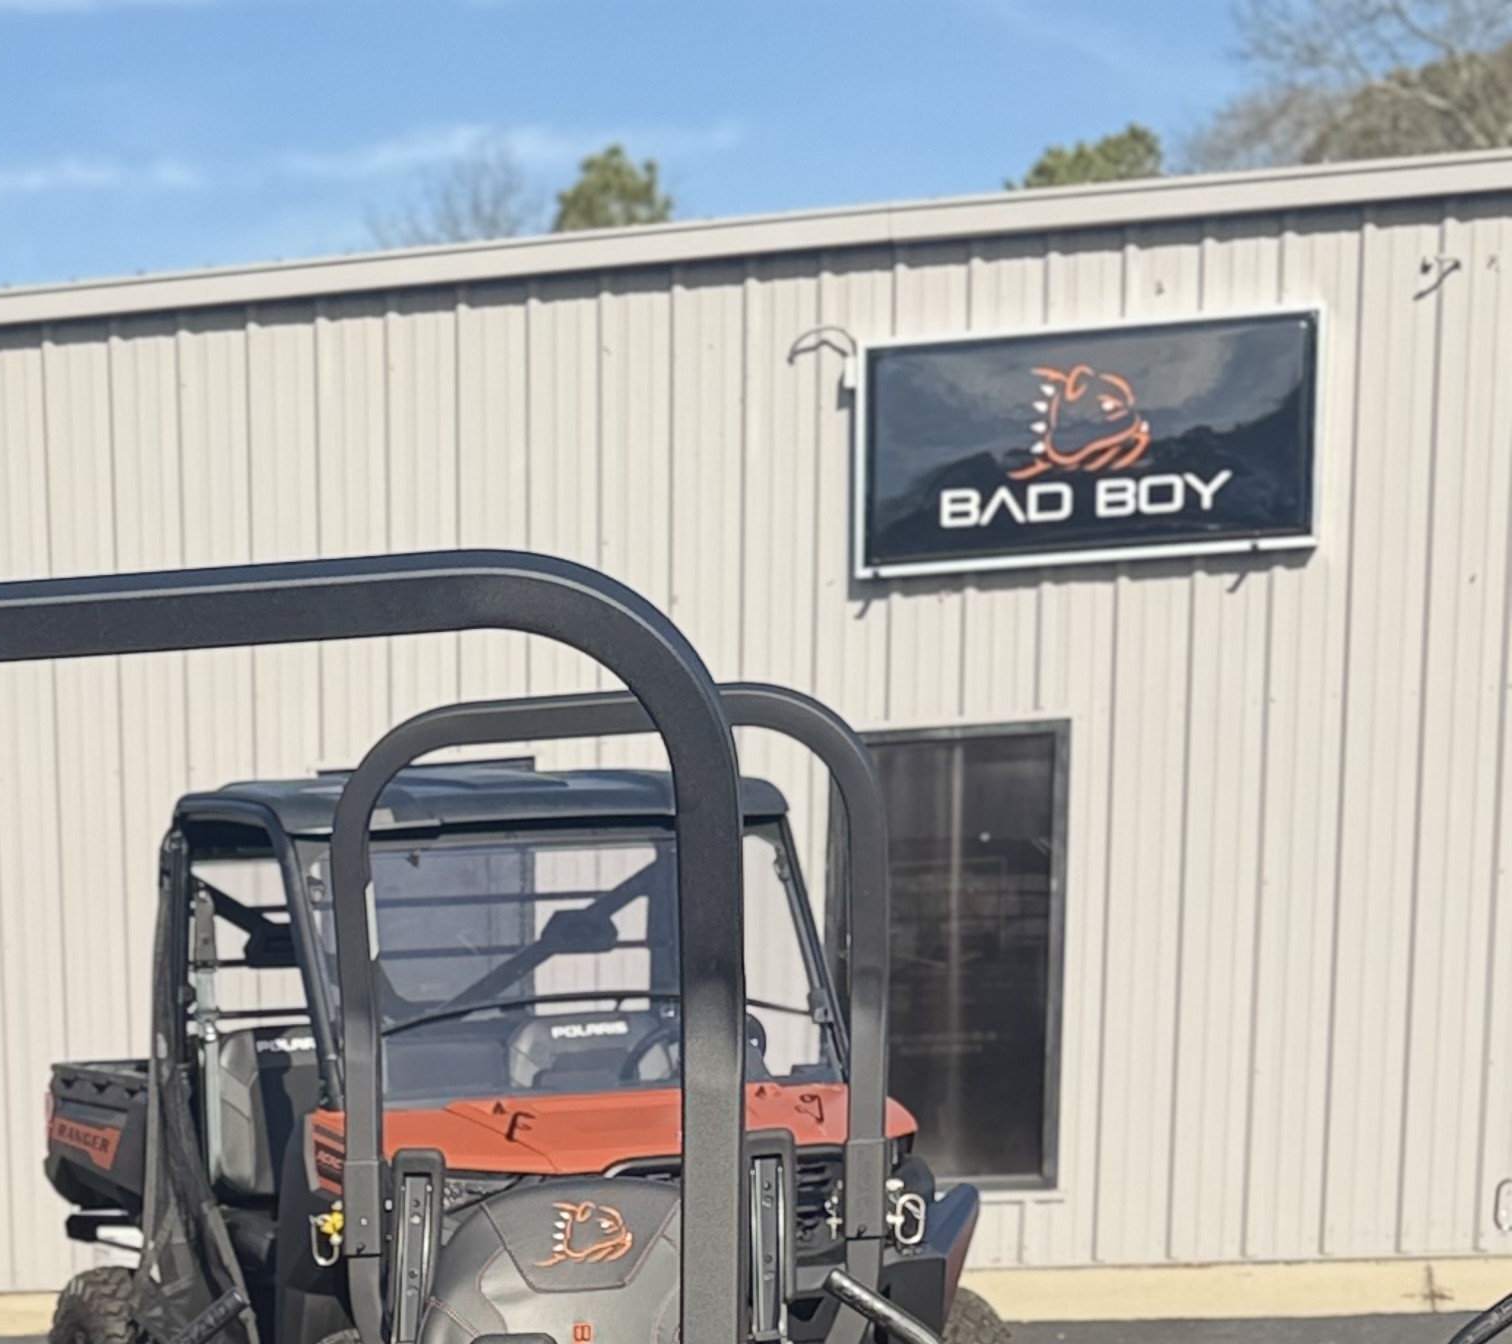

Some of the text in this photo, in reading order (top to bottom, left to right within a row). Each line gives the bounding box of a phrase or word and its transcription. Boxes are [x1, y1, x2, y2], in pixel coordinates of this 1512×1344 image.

[940, 470, 1233, 528] BAD BOY
[551, 1020, 629, 1040] POLARIS
[256, 1036, 317, 1054] POLAR
[56, 1123, 111, 1154] RANGER
